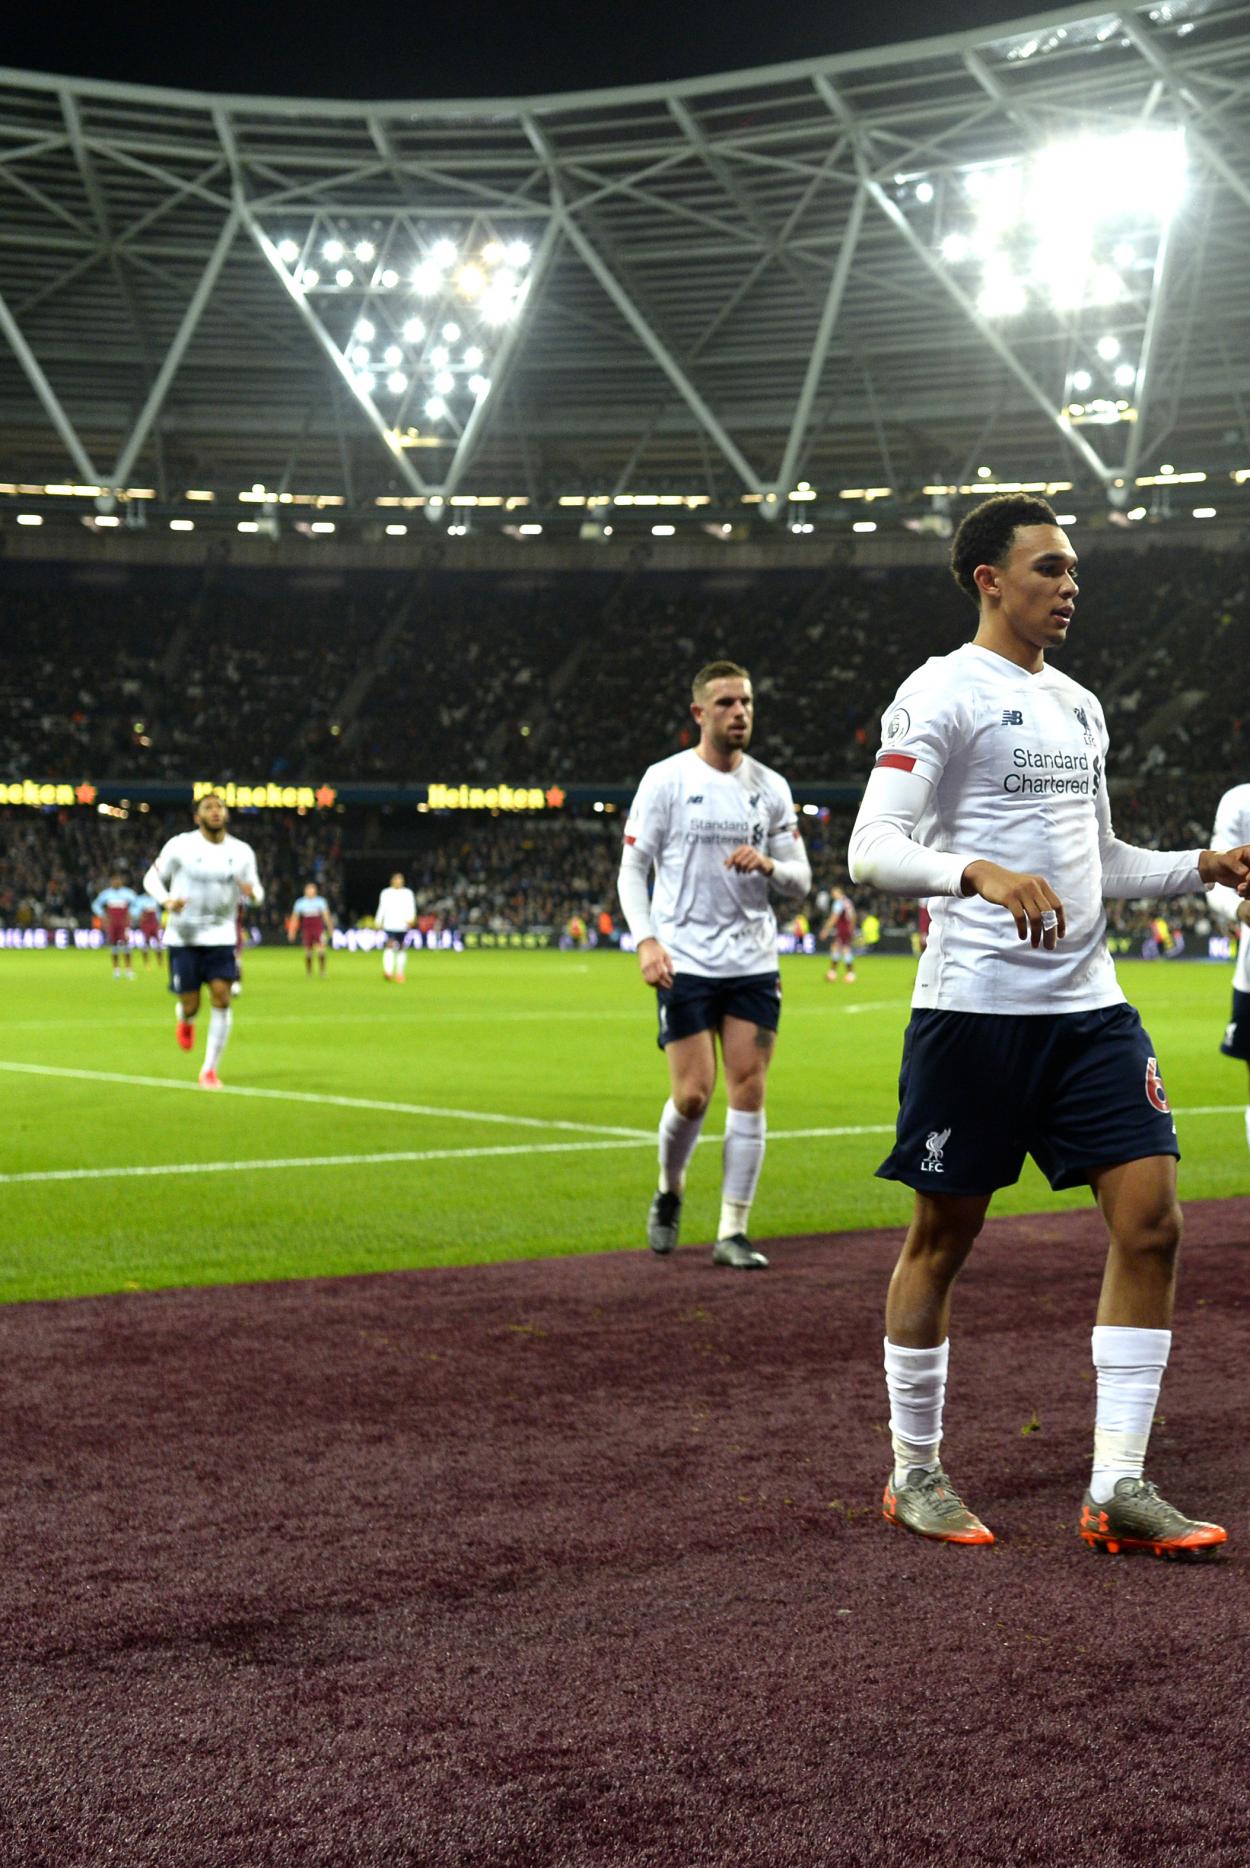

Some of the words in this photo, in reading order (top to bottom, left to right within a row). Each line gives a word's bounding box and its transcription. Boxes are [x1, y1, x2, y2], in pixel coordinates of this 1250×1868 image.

[1013, 748, 1089, 771] Standard
[1003, 773, 1089, 795] Chartered
[428, 784, 544, 808] Heineken
[690, 819, 749, 831] Standard
